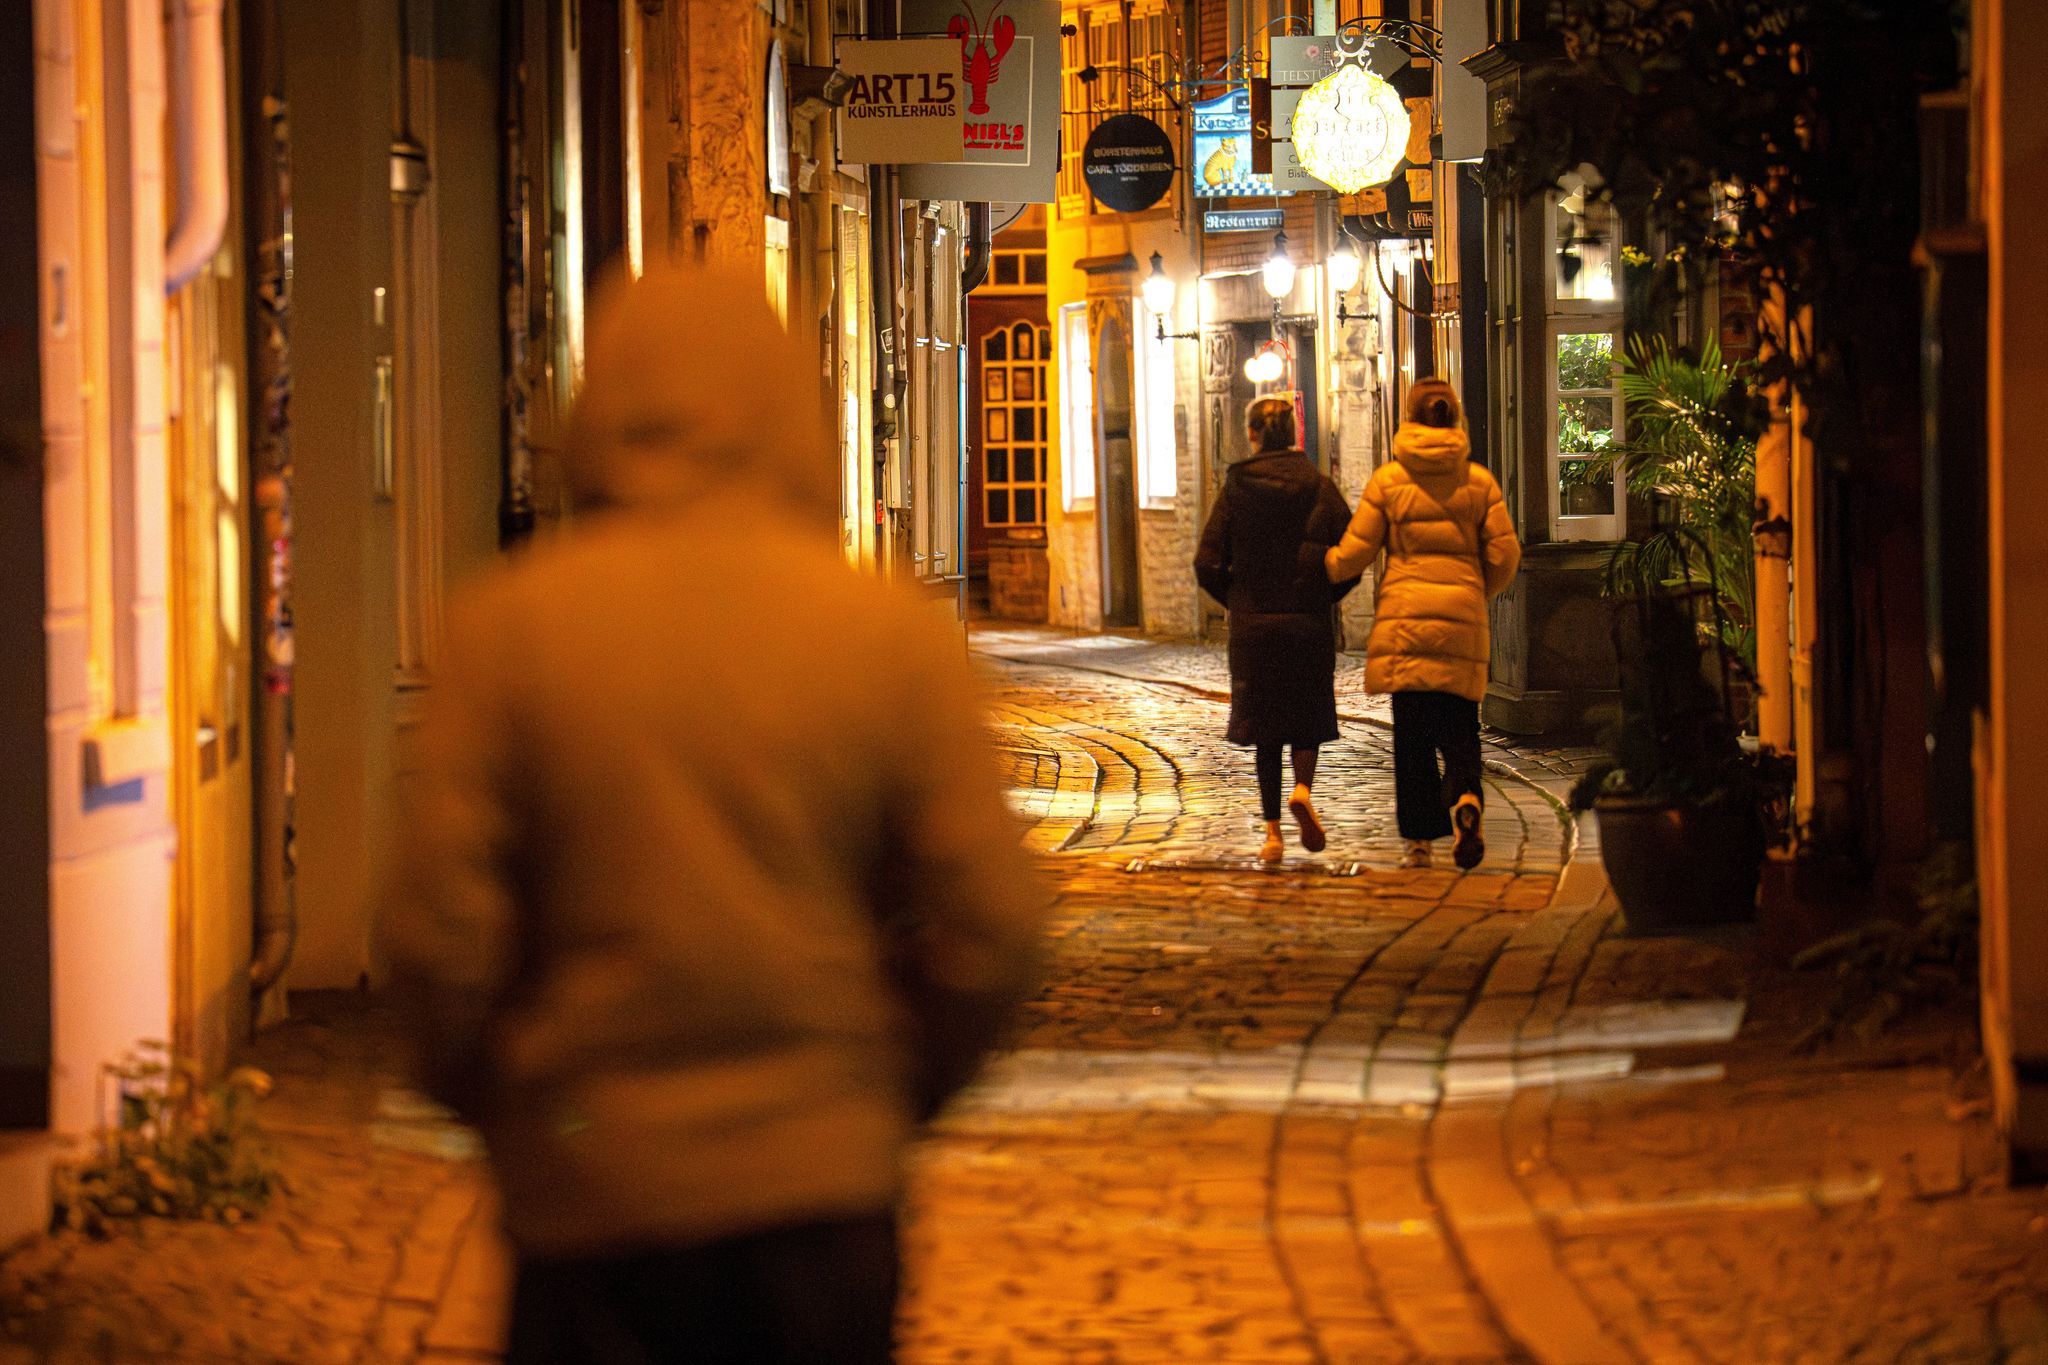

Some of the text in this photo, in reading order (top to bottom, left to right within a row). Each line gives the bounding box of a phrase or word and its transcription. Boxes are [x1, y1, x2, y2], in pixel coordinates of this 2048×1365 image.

[848, 104, 956, 119] KÜNSTLERHAUS
[963, 123, 1024, 142] NIEL'S
[1087, 164, 1113, 175] CARL
[1206, 214, 1283, 229] Restaurant
[1412, 212, 1433, 227] Wüs
